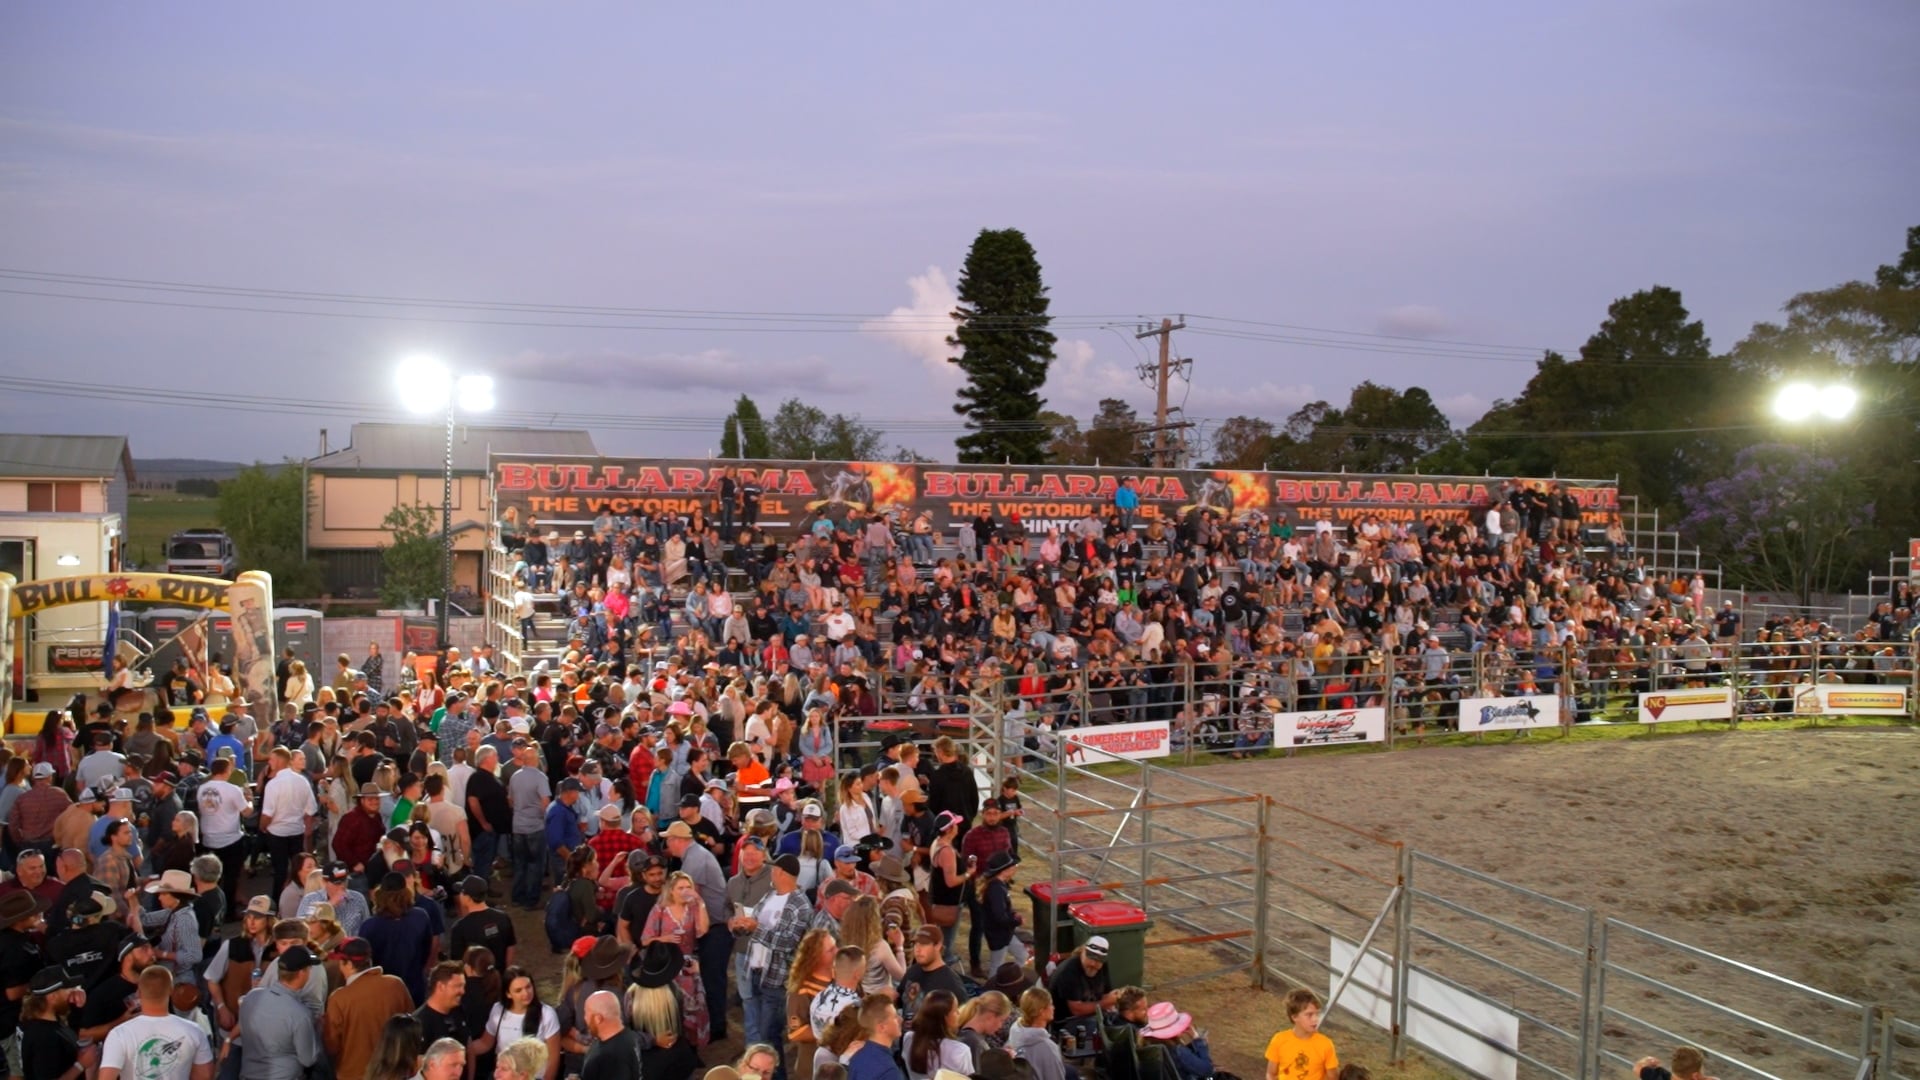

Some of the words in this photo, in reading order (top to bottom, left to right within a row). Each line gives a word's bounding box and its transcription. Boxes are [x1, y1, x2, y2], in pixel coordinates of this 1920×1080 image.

[923, 471, 1188, 501] BULLARAMA
[1276, 479, 1490, 506] BULLARAMA
[528, 496, 579, 512] THE
[949, 502, 993, 517] THE
[1101, 504, 1165, 519] HEL
[1297, 507, 1332, 520] THE
[1581, 511, 1609, 524] THE
[1021, 519, 1081, 534] HINTO
[13, 577, 99, 611] BULL
[157, 577, 230, 607] RIDE
